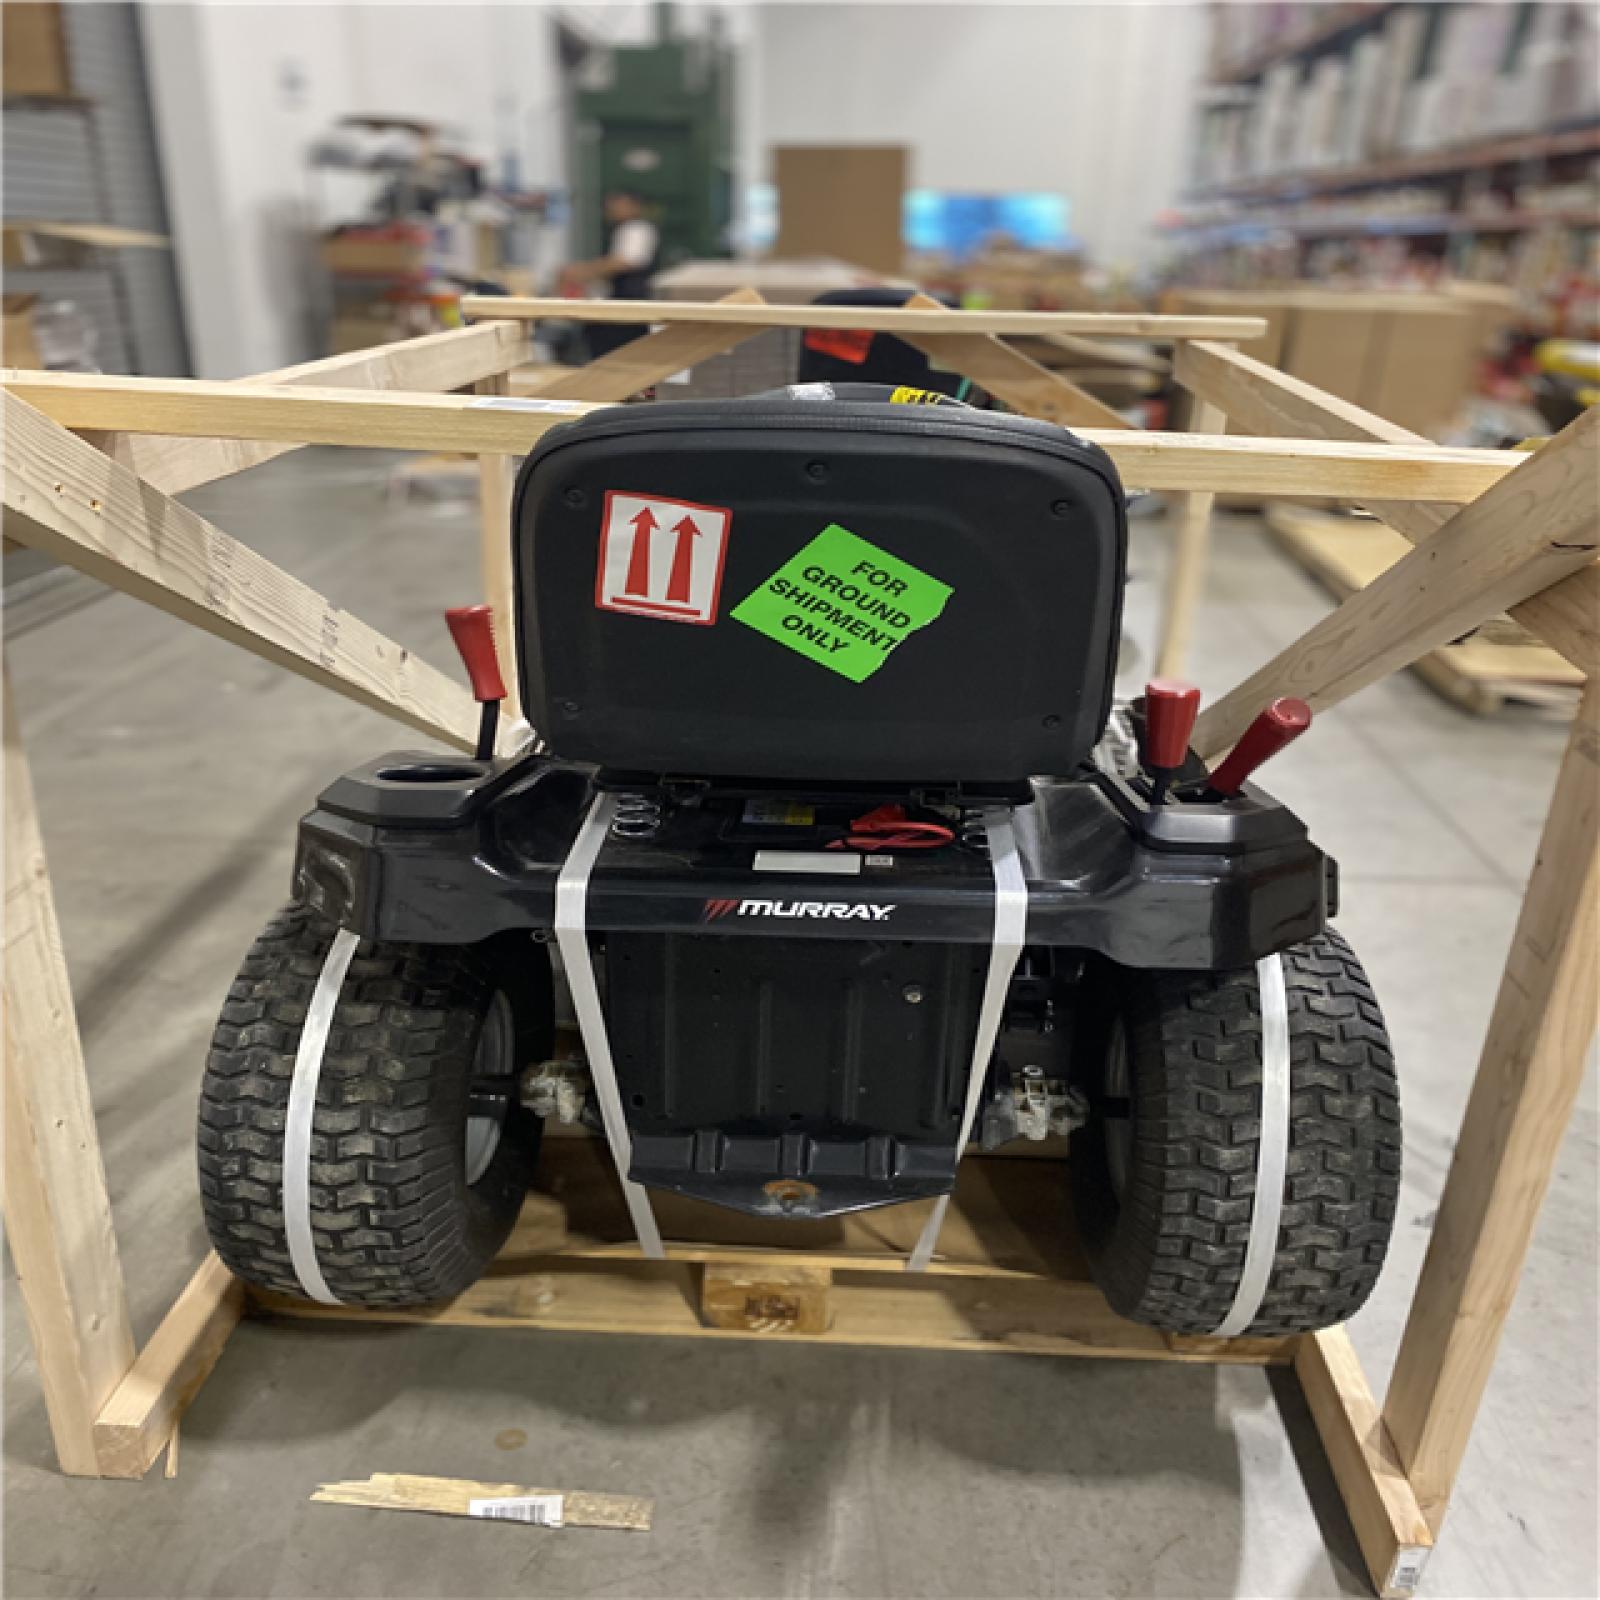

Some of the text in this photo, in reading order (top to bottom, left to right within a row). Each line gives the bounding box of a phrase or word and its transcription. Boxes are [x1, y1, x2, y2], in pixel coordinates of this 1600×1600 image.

[802, 566, 911, 629] GROUND
[852, 560, 908, 597] FOR
[769, 578, 898, 651] SHIPMENT
[782, 615, 849, 653] ONLY
[737, 899, 897, 921] MURRAY
